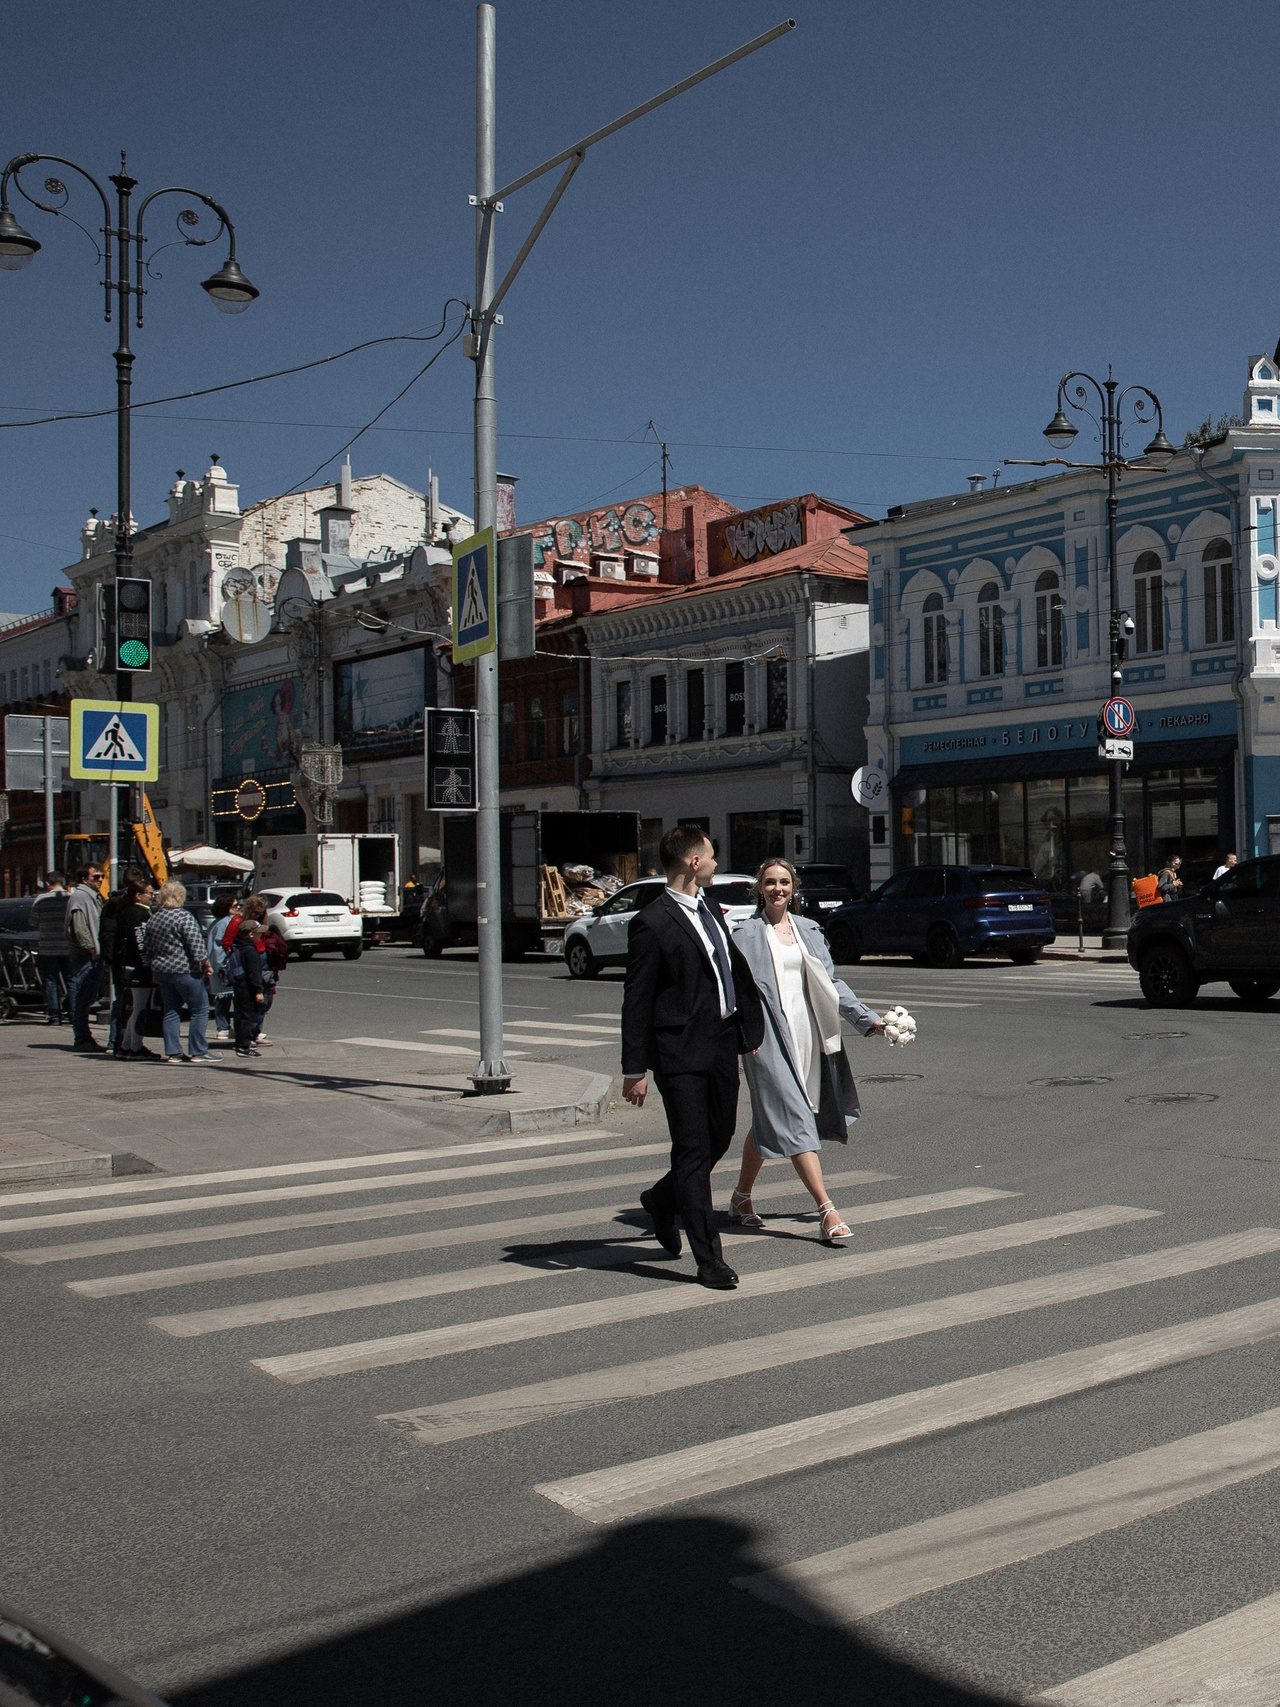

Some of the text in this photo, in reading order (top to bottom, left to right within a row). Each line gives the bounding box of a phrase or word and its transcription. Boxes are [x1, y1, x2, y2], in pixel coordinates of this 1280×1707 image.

[923, 713, 1210, 752] РЕМЕСЛЕННАЯ БЕЛОТУА ПЕКАРНЯ
